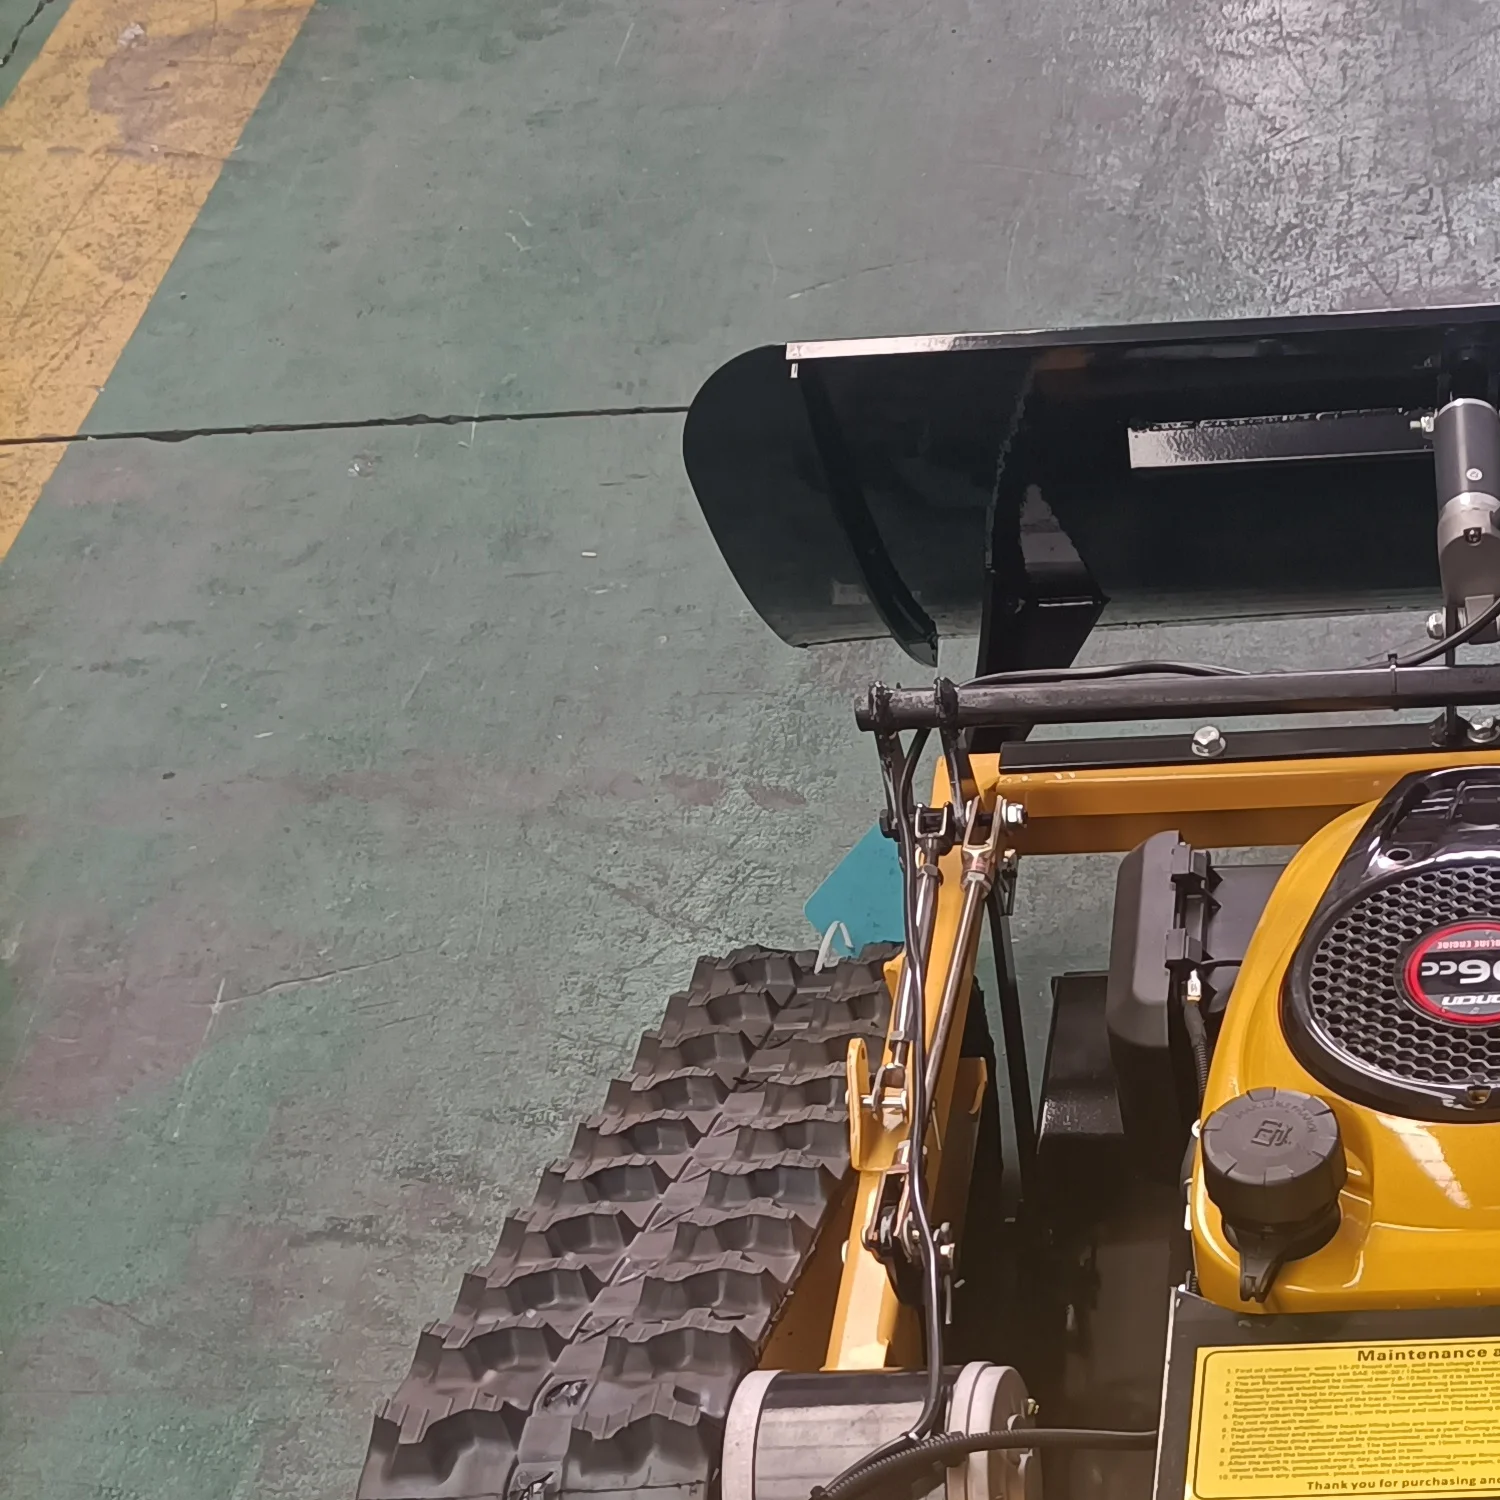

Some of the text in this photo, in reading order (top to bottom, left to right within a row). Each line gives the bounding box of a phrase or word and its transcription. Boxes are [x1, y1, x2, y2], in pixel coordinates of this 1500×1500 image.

[1357, 1348, 1488, 1362] Maintenance
[1307, 1480, 1347, 1490] Thank
[1351, 1480, 1376, 1491] you
[1379, 1478, 1398, 1487] for
[1402, 1475, 1476, 1489] purchasing
